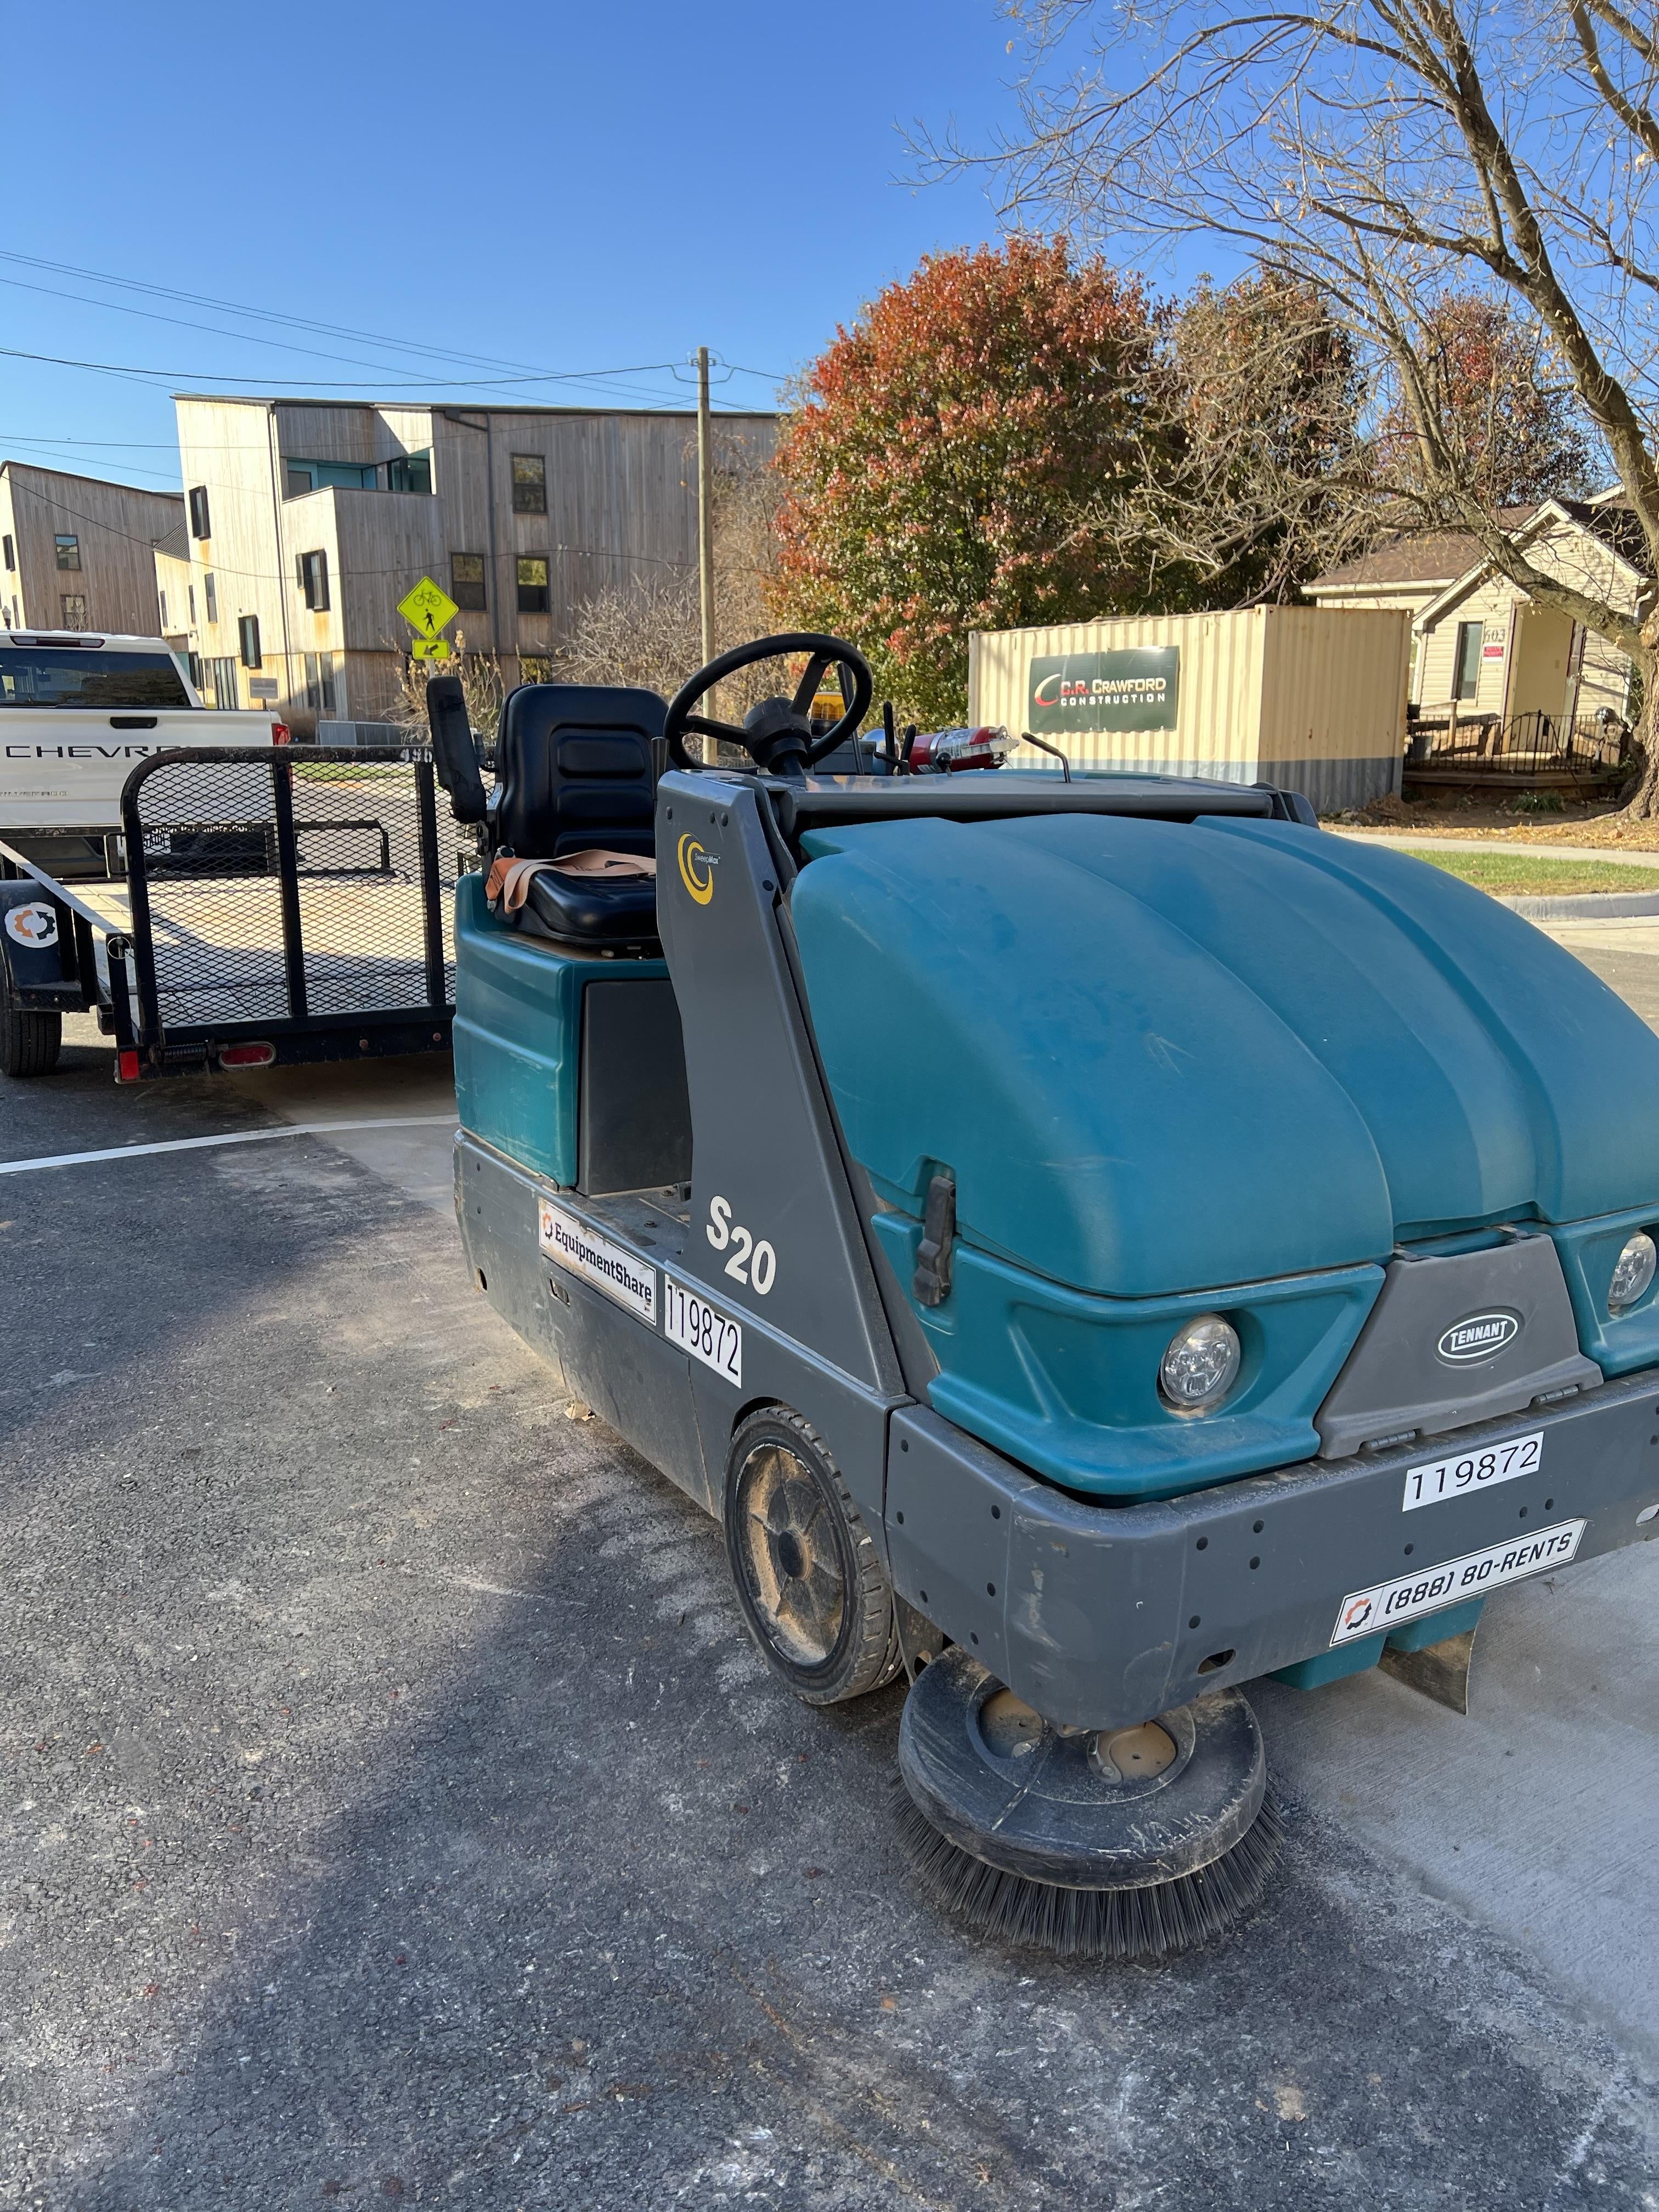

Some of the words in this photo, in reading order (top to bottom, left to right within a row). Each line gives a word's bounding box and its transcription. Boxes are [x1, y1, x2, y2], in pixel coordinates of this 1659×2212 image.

[1483, 629, 1505, 642] 603
[1060, 680, 1090, 696] C.R.
[1060, 693, 1165, 707] CONSTRUCTION
[555, 1222, 652, 1302] EquipmentShare
[706, 1195, 776, 1295] S20
[667, 1284, 738, 1376] 119872
[1451, 1321, 1508, 1351] TENNANT
[1413, 1441, 1538, 1499] 119872
[1385, 1572, 1454, 1615] (888)
[1460, 1532, 1573, 1587] 80-RENTS
